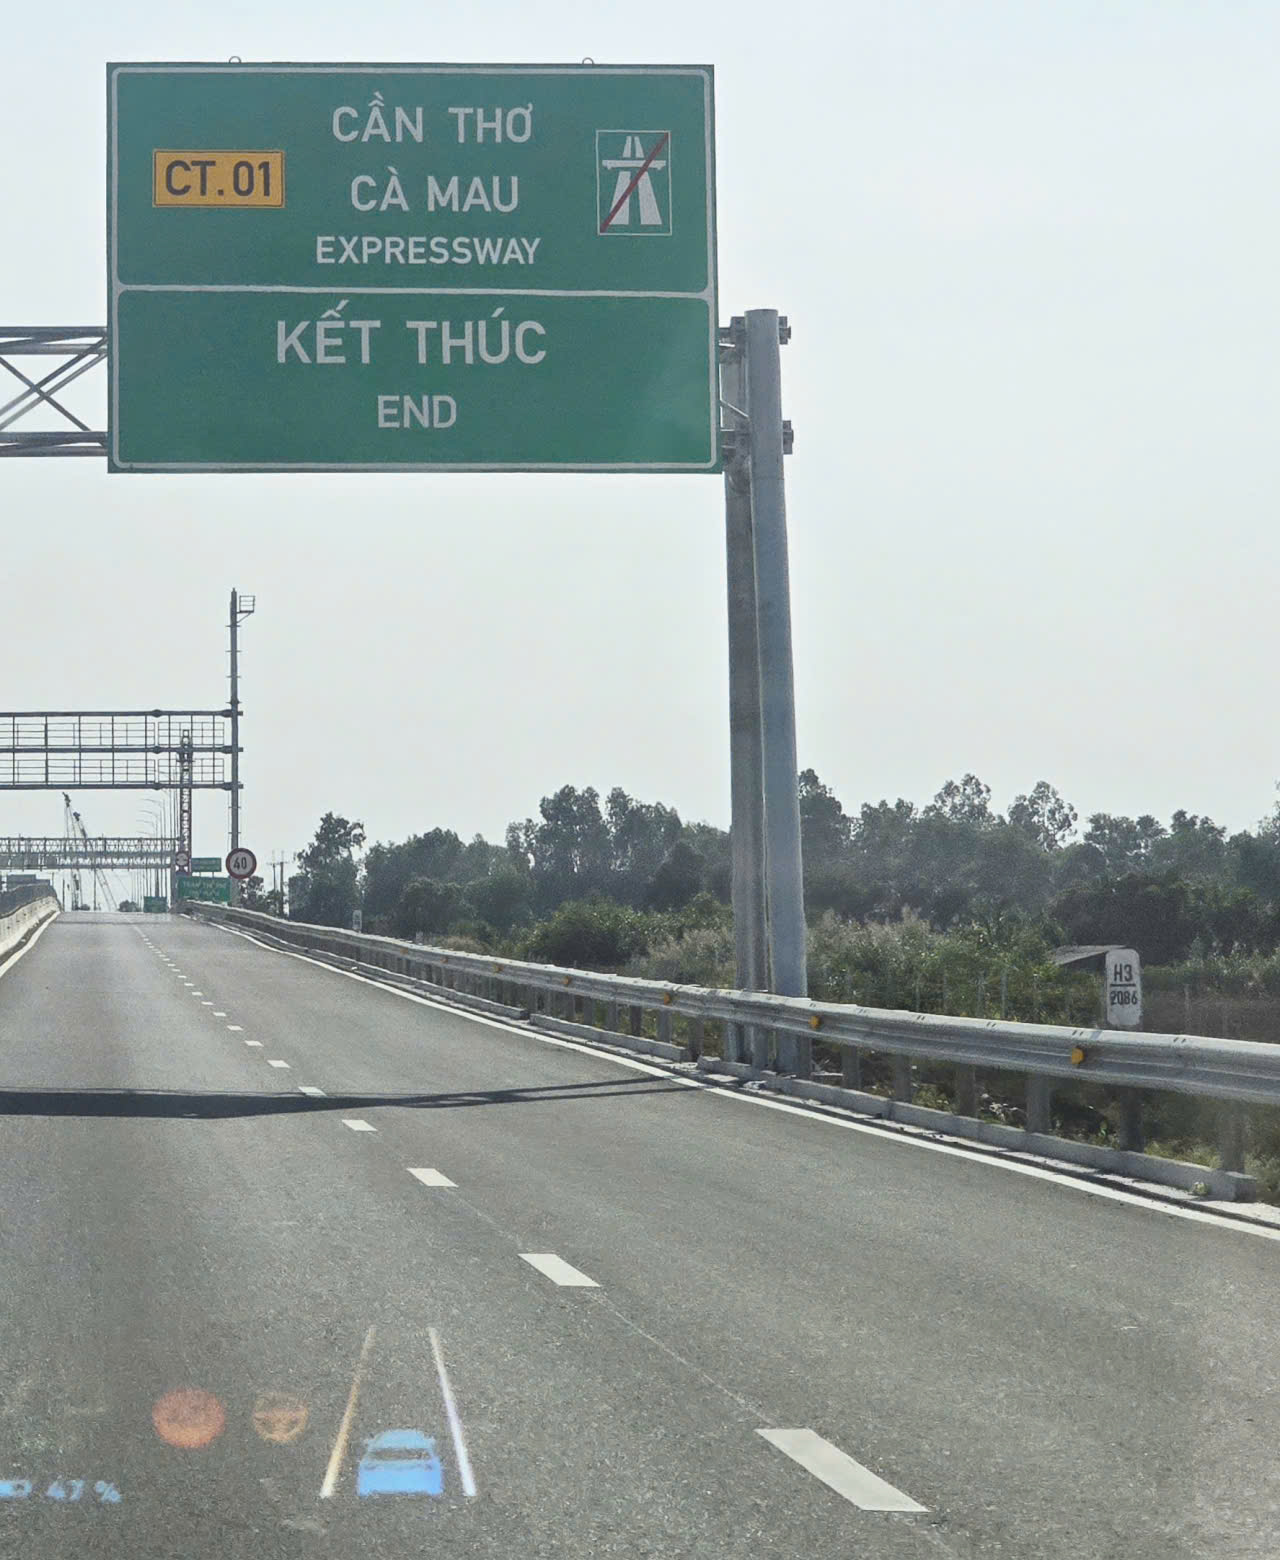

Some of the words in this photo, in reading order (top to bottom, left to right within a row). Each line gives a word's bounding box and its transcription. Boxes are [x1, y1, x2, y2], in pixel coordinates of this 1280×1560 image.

[332, 91, 424, 143] CẦN
[448, 103, 535, 143] THƠ
[165, 160, 272, 197] CT.01
[351, 166, 409, 212] CÀ
[427, 175, 519, 213] MAU
[316, 236, 541, 265] EXPRESSWAY
[277, 299, 381, 364] KẾT
[406, 307, 547, 365] THÚC
[377, 395, 457, 429] END
[233, 856, 247, 870] 40
[1114, 964, 1133, 982] H3
[1110, 990, 1138, 1006] 2086
